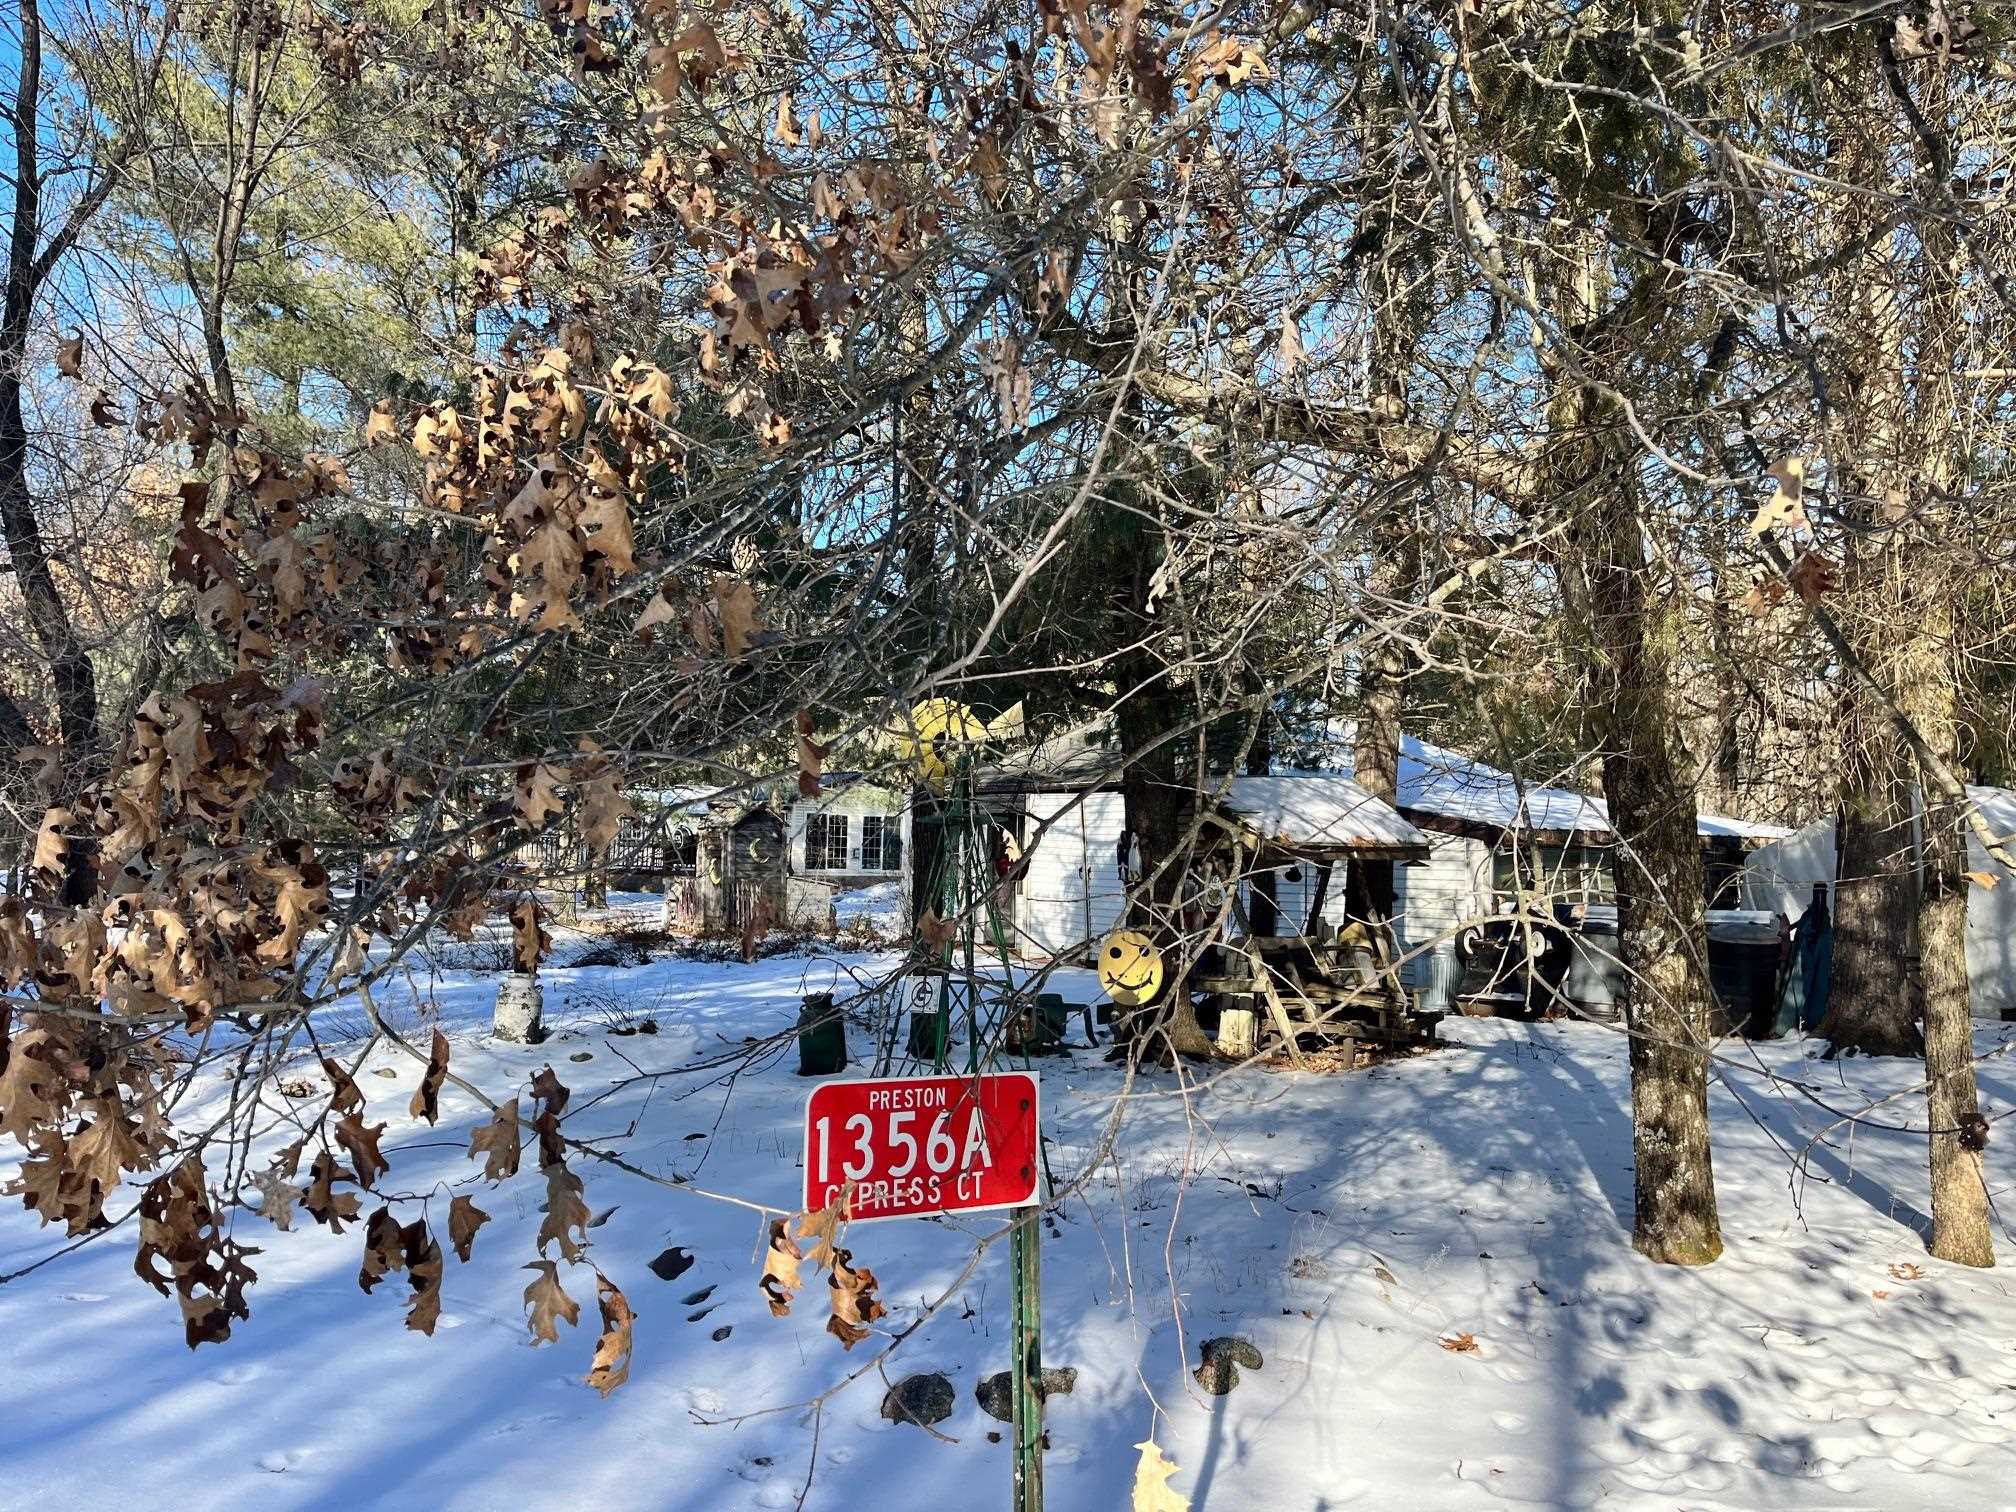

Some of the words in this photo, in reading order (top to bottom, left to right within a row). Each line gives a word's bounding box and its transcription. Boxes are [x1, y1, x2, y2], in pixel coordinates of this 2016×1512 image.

[870, 1087, 946, 1110] PRESTON
[816, 1106, 993, 1183] 1356A
[825, 1174, 941, 1211] CPRESS
[957, 1171, 984, 1201] CT
